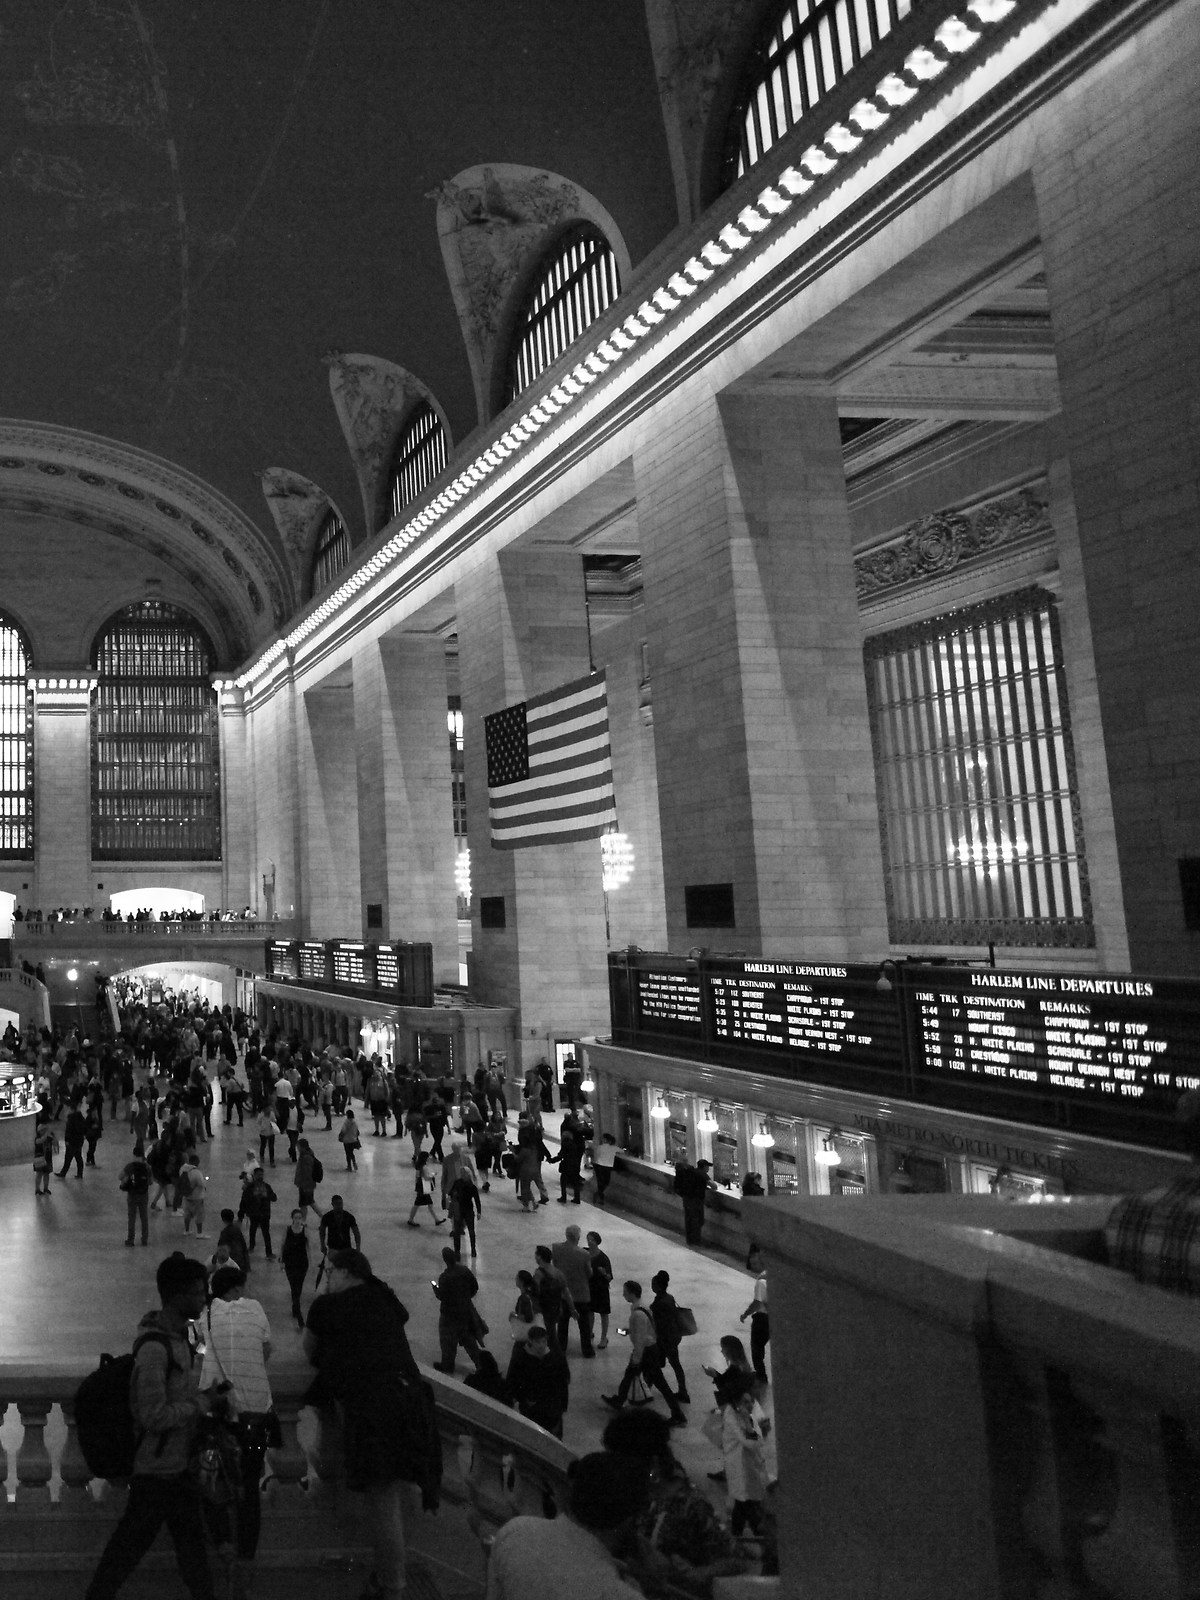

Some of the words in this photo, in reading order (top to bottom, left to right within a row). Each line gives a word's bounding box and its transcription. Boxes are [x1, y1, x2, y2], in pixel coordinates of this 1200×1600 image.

[744, 963, 775, 974] HARLEM
[776, 964, 794, 974] LINE
[795, 965, 848, 978] DEPARTURES
[739, 980, 776, 990] DESTINATION
[784, 983, 813, 991] REMARKS
[971, 974, 1023, 989] HARLEM
[1026, 977, 1057, 990] LINE
[1060, 978, 1153, 996] DEPARTURES
[787, 1005, 802, 1014] WHITE
[803, 1007, 822, 1016] PLAINS
[820, 997, 829, 1005] 1ST
[831, 998, 845, 1006] STOP
[915, 992, 934, 1002] TIME
[939, 994, 958, 1004] TRK
[963, 995, 1025, 1009] DESTINATION
[1039, 1001, 1091, 1014] REMARKS
[750, 1012, 764, 1020] WHITE
[765, 1013, 782, 1022] PLAINS
[788, 1016, 814, 1026] SCARSDALE
[821, 1020, 831, 1028] 1ST
[832, 1021, 846, 1029] STOP
[921, 1005, 938, 1015] 5:44
[952, 1008, 960, 1017] 17
[967, 1009, 1005, 1022] SOUTHEAST
[1044, 1016, 1089, 1030] CHAPPAQUA
[1104, 1021, 1120, 1033] 1ST
[1124, 1023, 1148, 1036] STOP
[751, 1033, 765, 1041] WHITE
[766, 1035, 783, 1044] PLAINS
[818, 1042, 827, 1050] 1ST
[828, 1043, 842, 1052] STOP
[825, 1032, 837, 1040] WEST
[858, 1036, 872, 1044] STOP
[968, 1023, 990, 1034] MOUNT
[992, 1025, 1016, 1038] KISCO
[1045, 1030, 1071, 1044] WHITE
[1074, 1033, 1107, 1047] PLAINS
[1122, 1038, 1138, 1050] 1ST
[1143, 1040, 1168, 1053] STOP
[923, 1032, 940, 1041] 5:52
[969, 1036, 978, 1046] N.
[981, 1037, 1004, 1049] WHITE
[1006, 1040, 1035, 1053] PLAINS
[1047, 1045, 1092, 1060] SCARSDALE
[1108, 1052, 1123, 1064] 1ST
[1127, 1054, 1152, 1067] STOP
[926, 1057, 942, 1067] 6:00
[972, 1063, 980, 1073] N.
[984, 1065, 1006, 1077] WHITE
[1009, 1068, 1038, 1082] PLAINS
[1050, 1074, 1085, 1089] MELROSE
[1100, 1081, 1116, 1093] 1ST
[1120, 1083, 1144, 1097] STOP
[954, 1048, 963, 1057] 21
[970, 1049, 1010, 1064] CRESTWOOD
[1048, 1059, 1073, 1073] MOUNT
[1077, 1063, 1110, 1077] VERNON
[1113, 1068, 1136, 1081] WEST
[1153, 1073, 1170, 1086] 1ST
[1175, 1076, 1200, 1090] STOP
[854, 1114, 881, 1132] MTA
